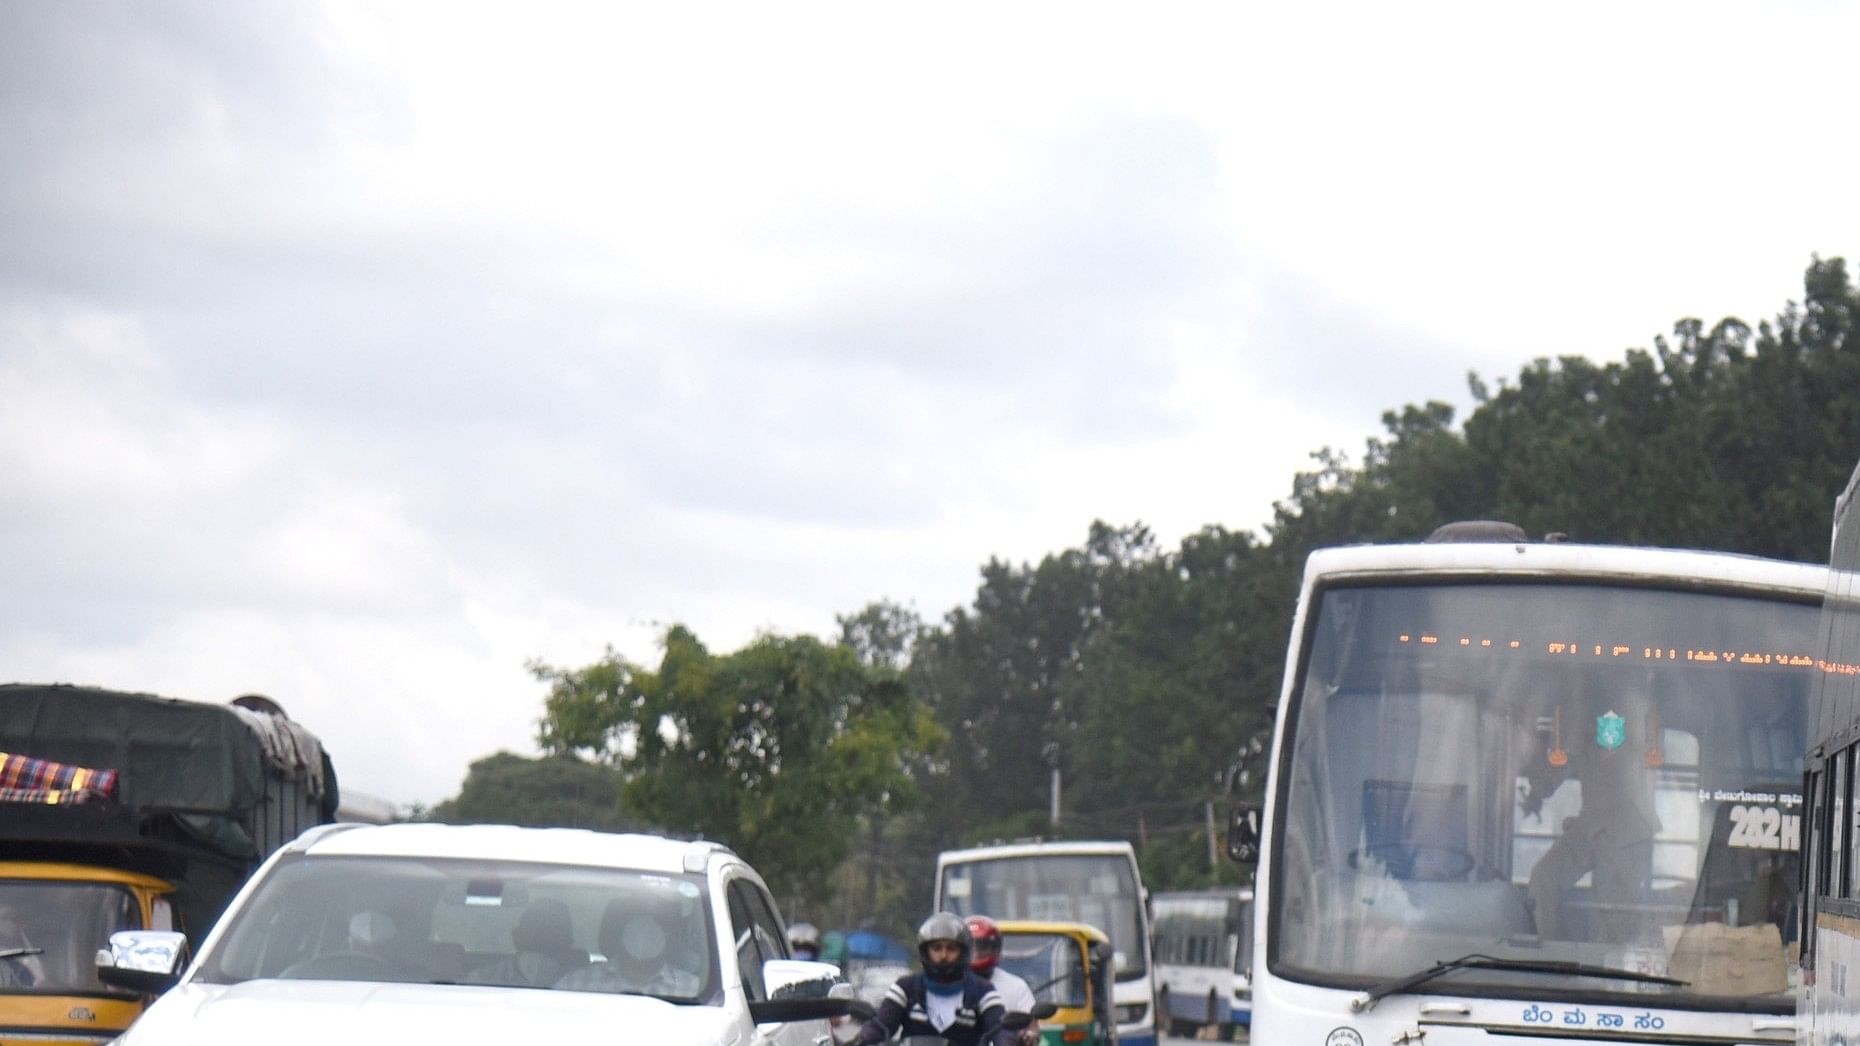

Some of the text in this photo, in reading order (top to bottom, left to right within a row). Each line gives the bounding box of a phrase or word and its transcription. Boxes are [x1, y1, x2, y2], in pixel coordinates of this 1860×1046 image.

[1523, 1004, 1665, 1030] ಬೆಂ ಮ ಸಾ ಸಂ
